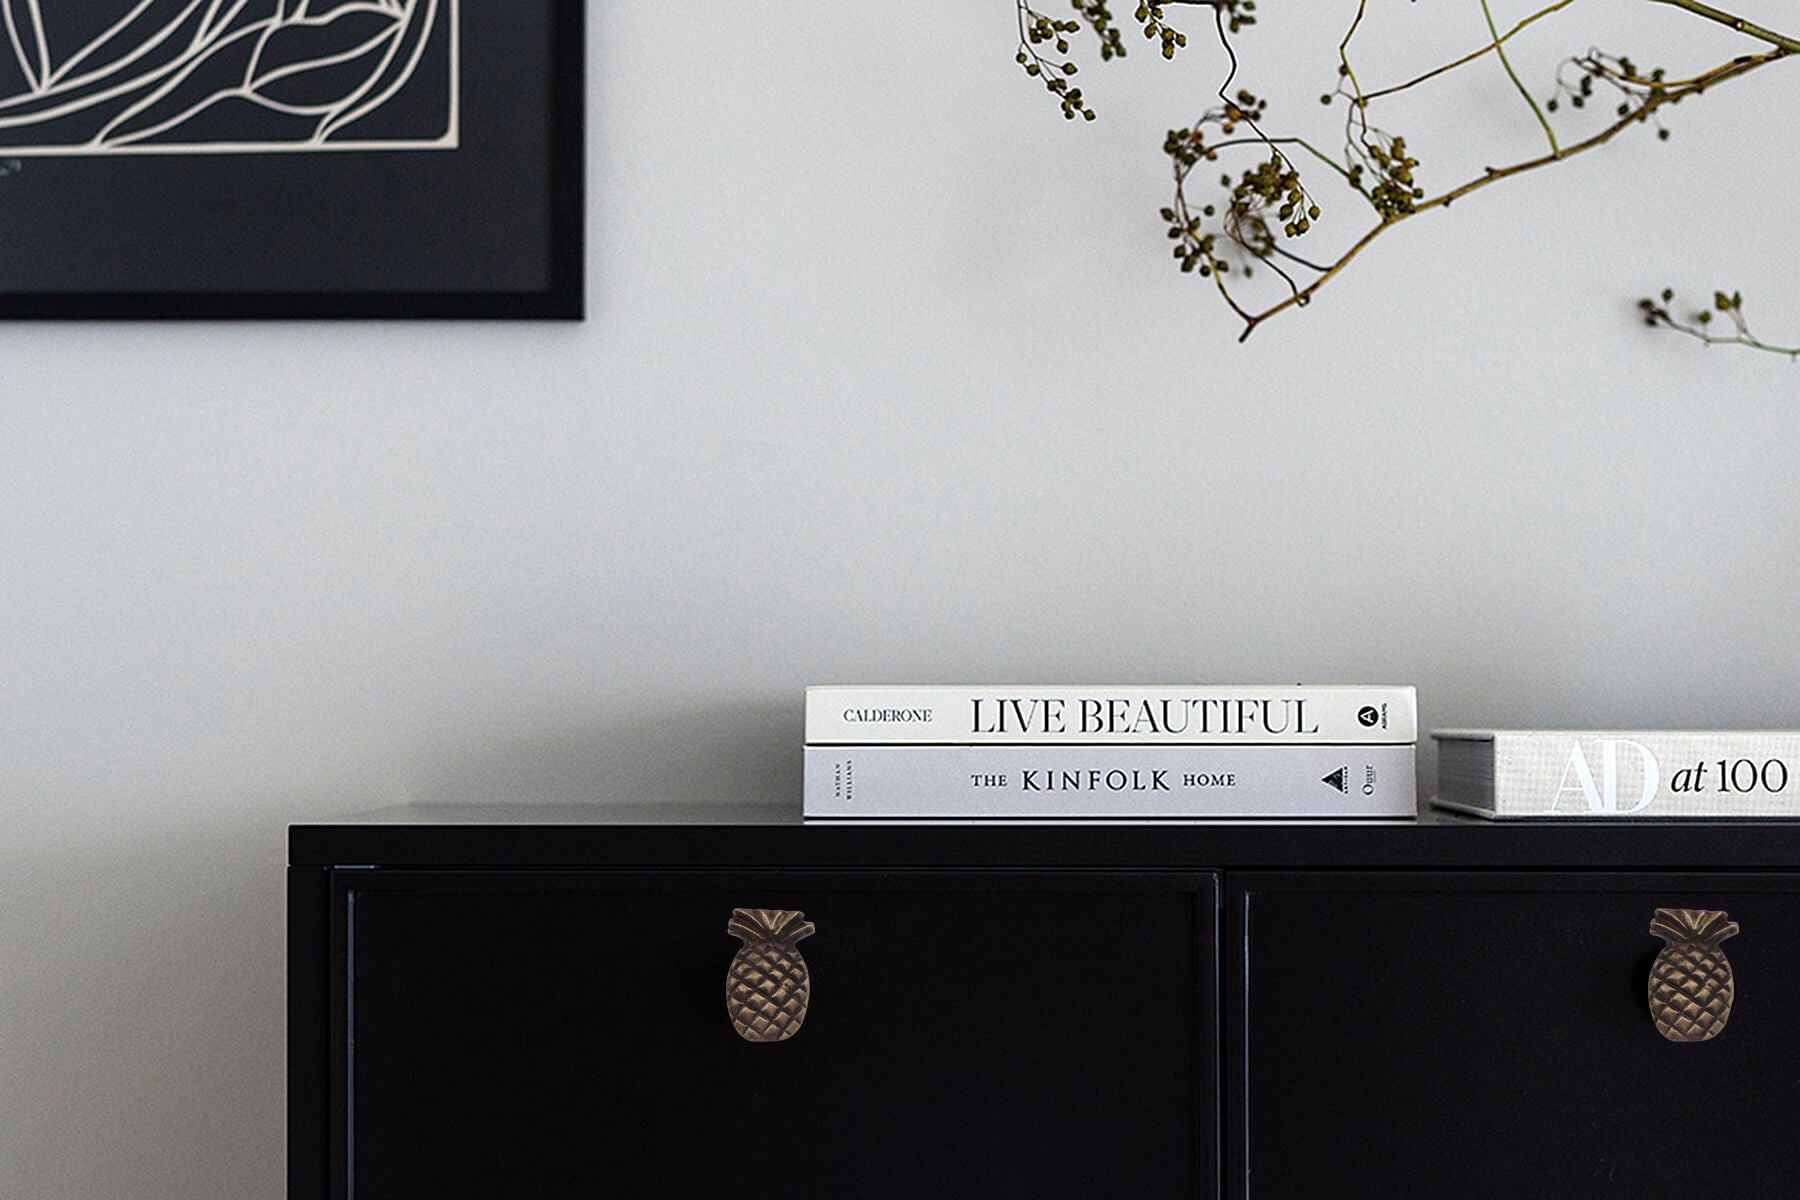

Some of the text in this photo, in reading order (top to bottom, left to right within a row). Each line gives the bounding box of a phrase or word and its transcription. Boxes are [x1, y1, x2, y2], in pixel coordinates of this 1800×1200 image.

[843, 709, 932, 722] CALDERONE
[970, 699, 1320, 734] LIVE BEAUTIFUL
[971, 770, 1236, 791] THE KINFOLK HOME
[1544, 739, 1788, 814] AD at 100
